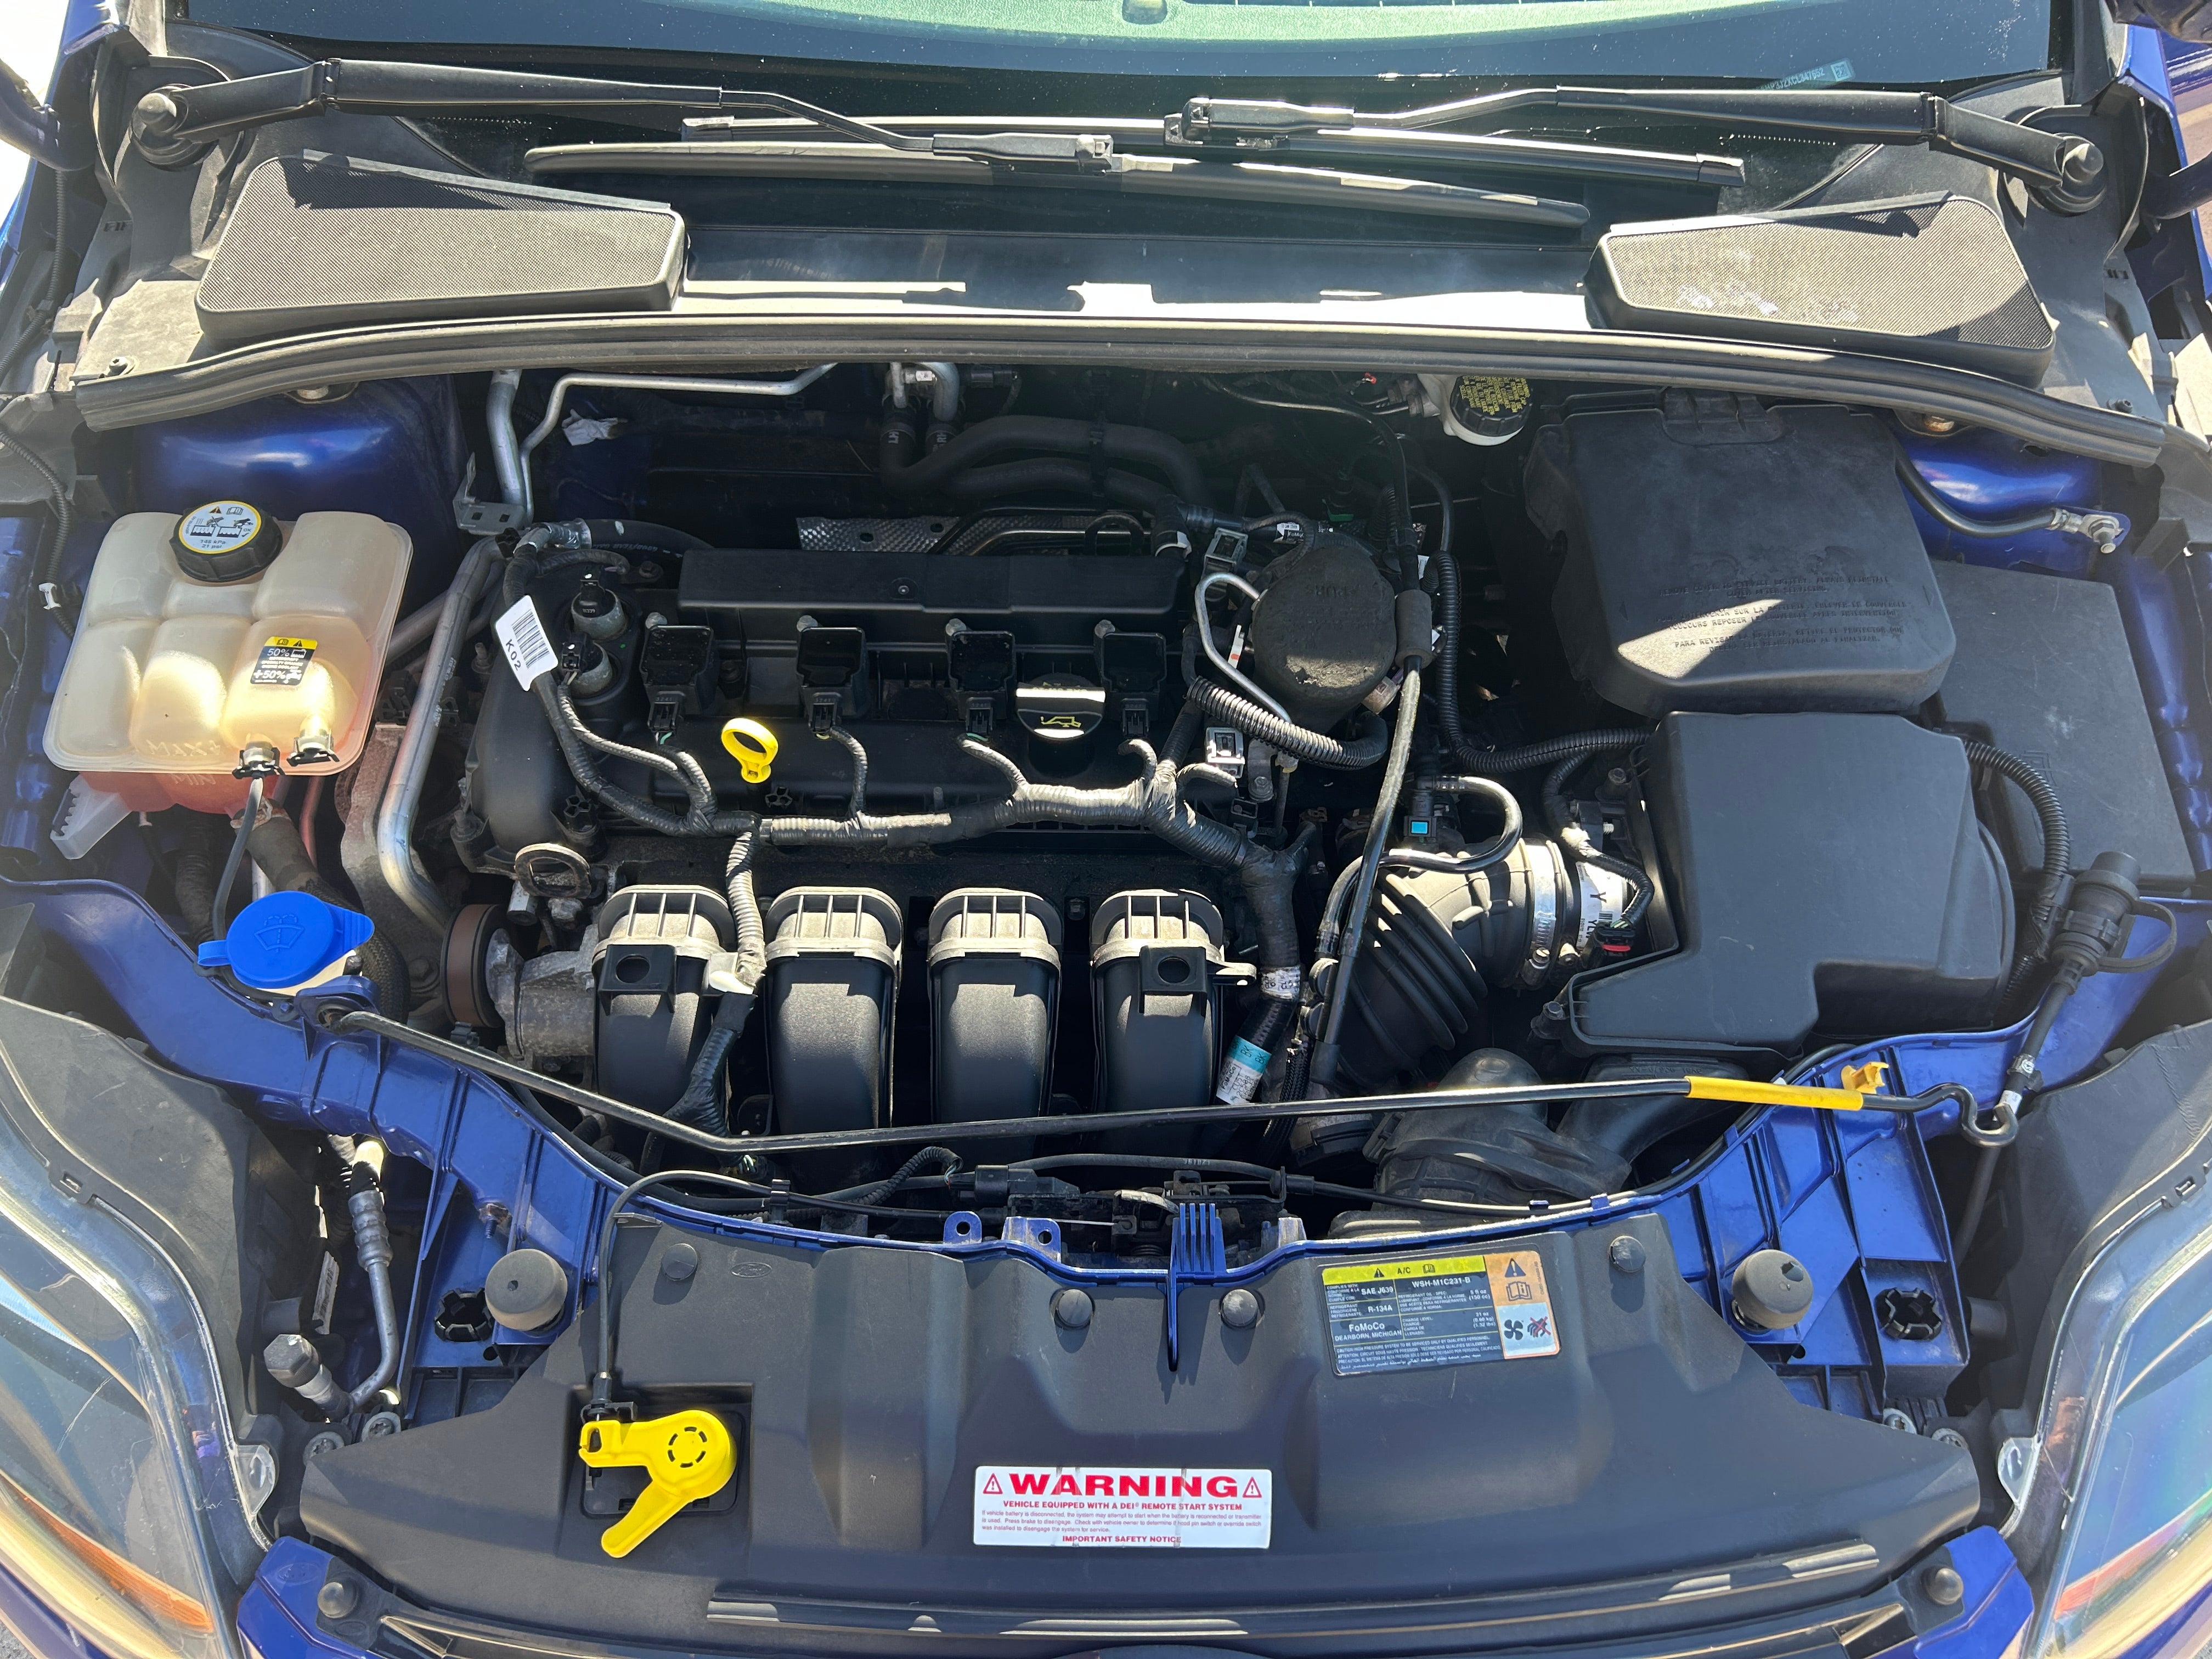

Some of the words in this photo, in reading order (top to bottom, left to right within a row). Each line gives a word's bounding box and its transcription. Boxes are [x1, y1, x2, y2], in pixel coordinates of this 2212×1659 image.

[888, 431, 899, 444] LH
[1711, 617, 1747, 626] REPOSER
[1674, 639, 1695, 647] PARA
[1699, 635, 1734, 645] REVISAR
[267, 648, 290, 657] 50%
[505, 638, 521, 672] K02
[146, 740, 207, 757] MAX
[168, 773, 216, 786] MIN
[1589, 891, 1607, 904] Y
[1240, 1045, 1254, 1058] BK
[1255, 1052, 1268, 1064] BK
[1221, 1065, 1237, 1090] FoMoCo
[1411, 1276, 1471, 1288] WSH-M1C231-B
[1361, 1287, 1376, 1295] SAE
[1367, 1304, 1392, 1313] R-134A
[1348, 1321, 1385, 1332] FoMoCo
[1371, 1329, 1402, 1338] MICHIGAN
[1008, 1473, 1238, 1498] WARNING
